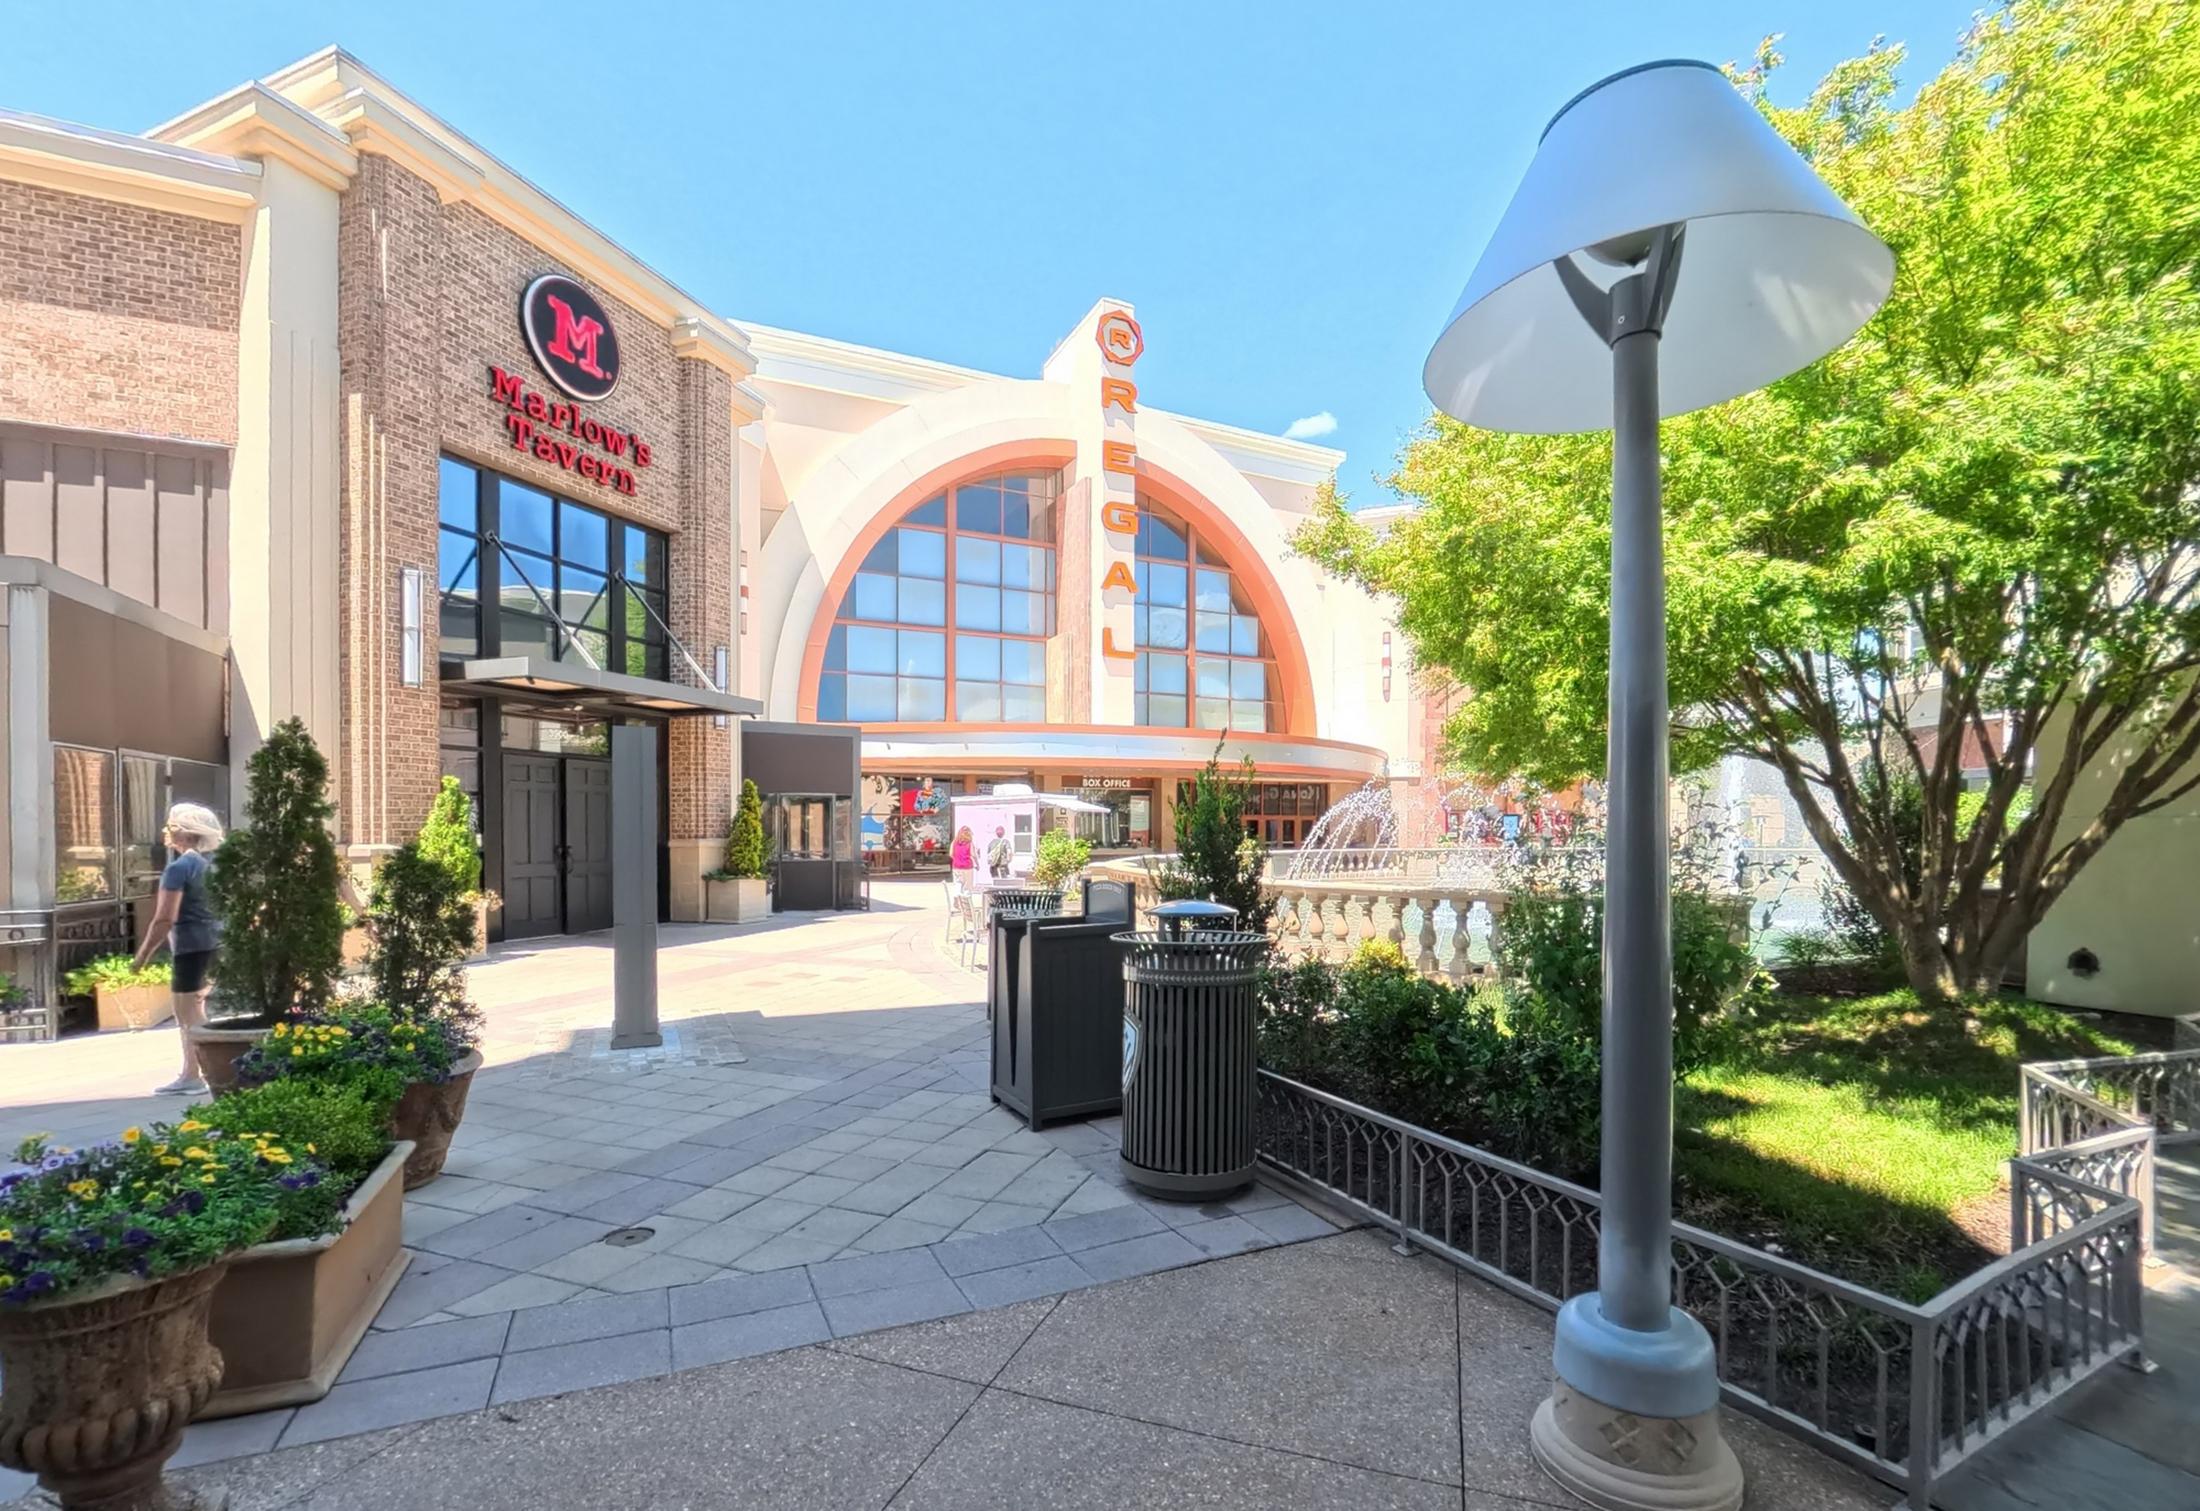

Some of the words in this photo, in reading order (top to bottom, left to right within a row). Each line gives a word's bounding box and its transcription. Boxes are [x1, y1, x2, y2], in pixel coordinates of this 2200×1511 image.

[1110, 327, 1131, 350] R
[490, 365, 652, 468] Marlow's
[508, 414, 638, 497] Tavern
[1101, 376, 1139, 661] REGAL
[1082, 778, 1101, 787] BOX
[1103, 778, 1132, 788] OFFICE
